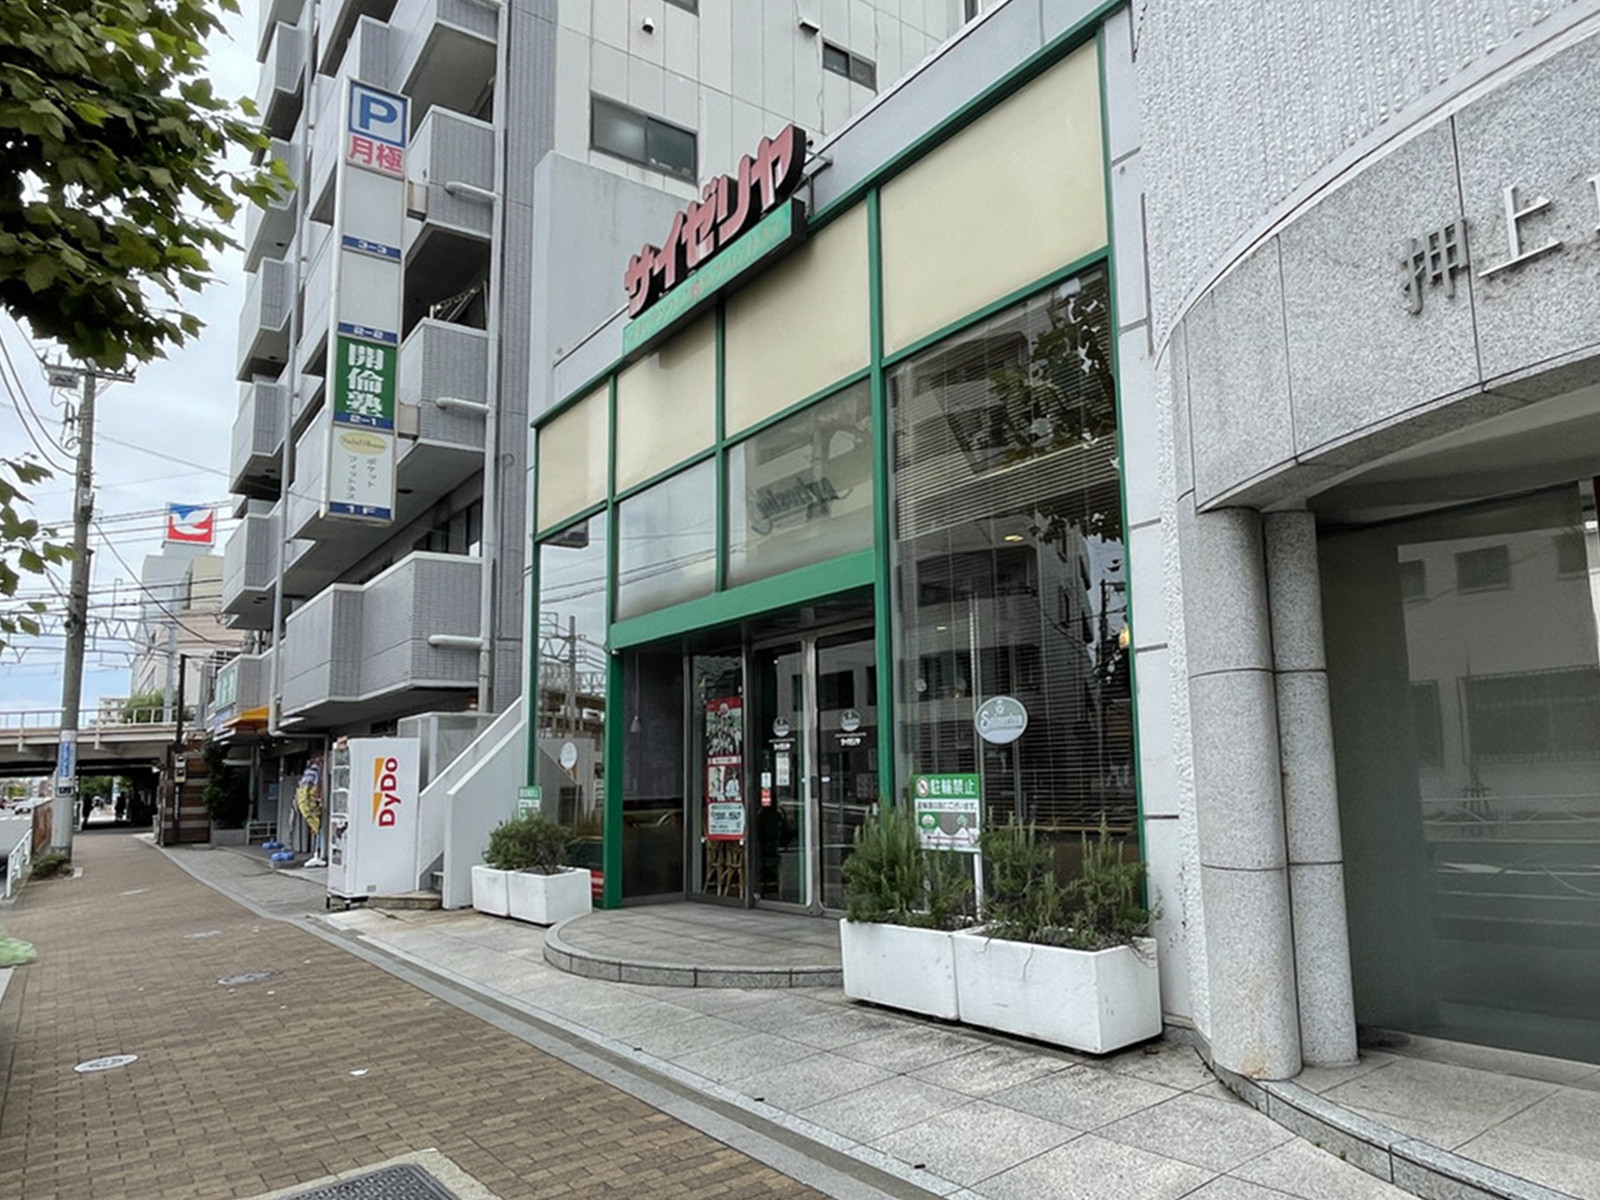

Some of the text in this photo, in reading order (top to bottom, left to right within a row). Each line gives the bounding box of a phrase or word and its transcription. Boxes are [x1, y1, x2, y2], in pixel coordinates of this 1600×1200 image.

[359, 94, 398, 131] P
[349, 135, 403, 173] 月極
[622, 124, 806, 319] サイゼリヤ
[1401, 173, 1600, 316] 押上
[345, 343, 385, 418] 開倫塾
[379, 757, 401, 828] DyDo
